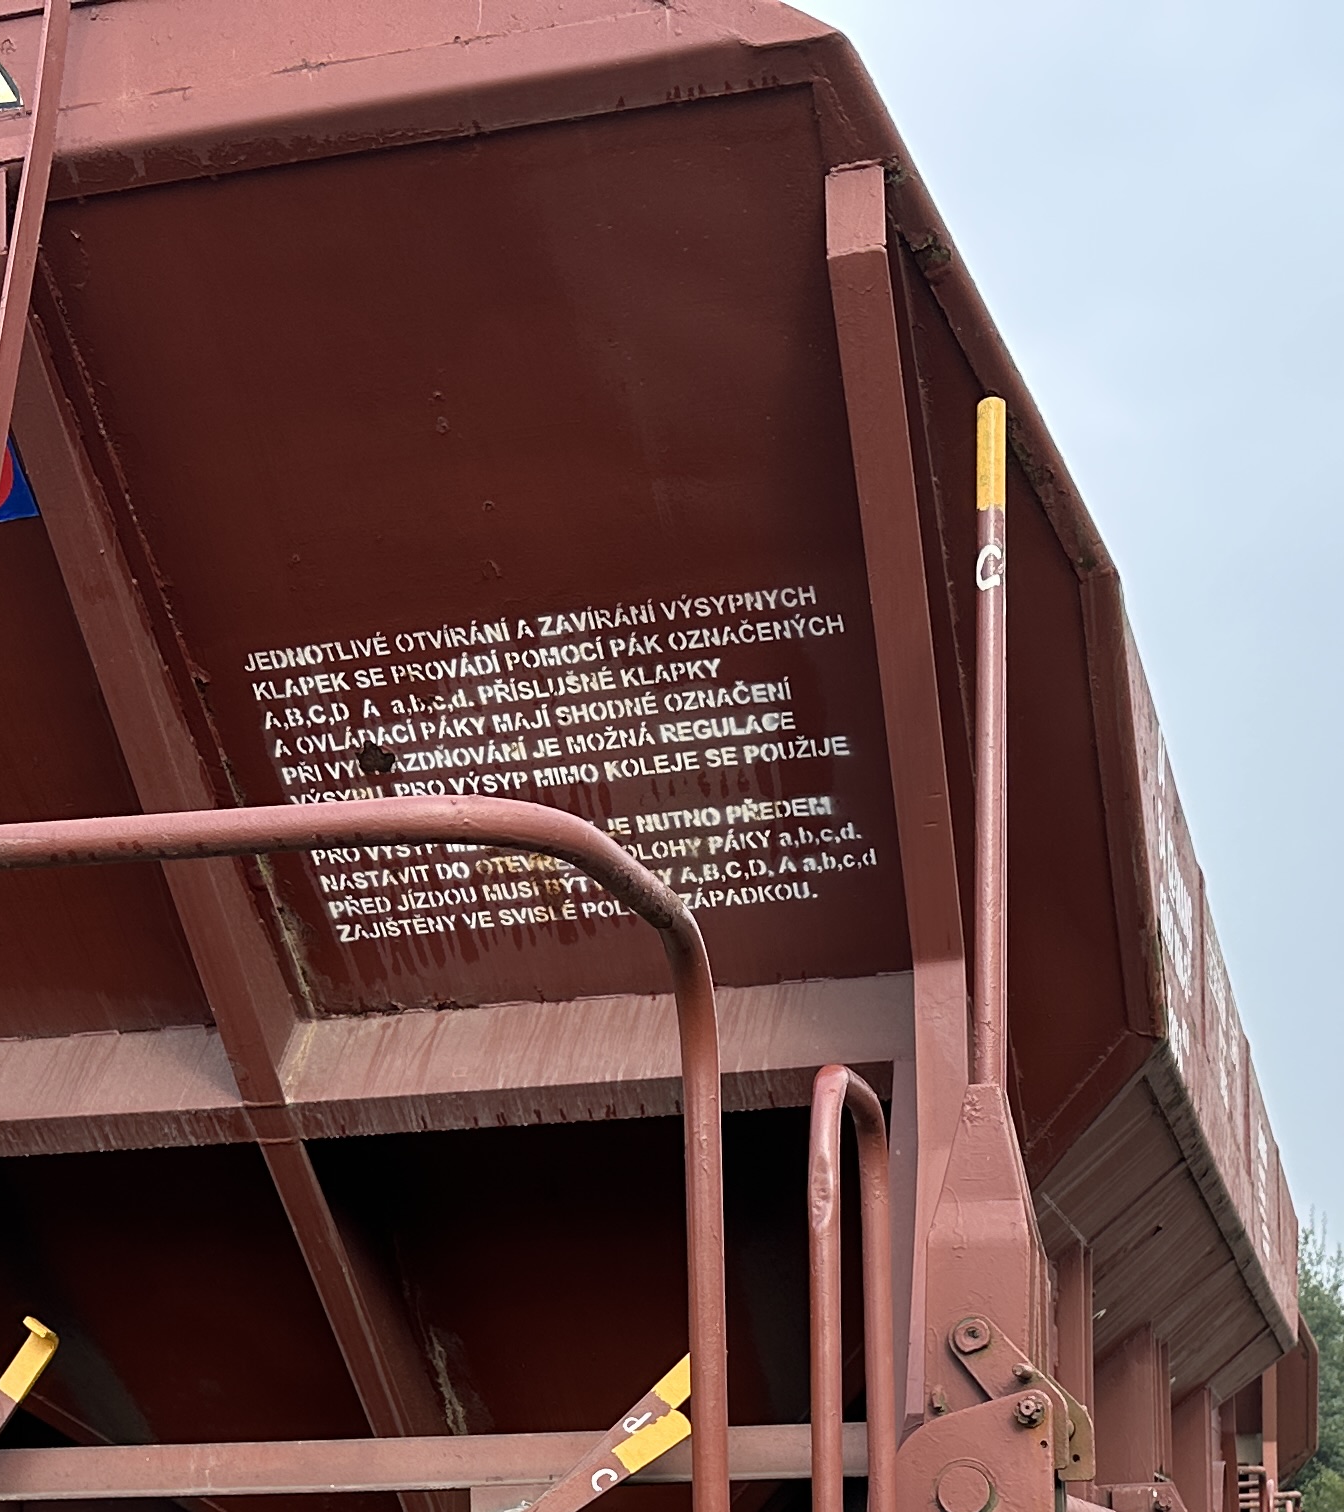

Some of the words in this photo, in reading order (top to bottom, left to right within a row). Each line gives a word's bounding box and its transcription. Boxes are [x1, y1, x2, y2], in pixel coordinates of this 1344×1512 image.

[244, 632, 391, 673] JEDNOTLIVÉ
[395, 617, 511, 653] OTVÍRÁNÍ
[517, 618, 535, 641] A
[537, 599, 657, 638] ZAVÍRÁNÍ
[252, 671, 351, 702] KLAPEK
[354, 667, 388, 689] SE
[390, 649, 501, 685] PROVÁDÍ
[505, 636, 605, 671] POMOCÍ
[611, 631, 664, 659] PÁK
[667, 613, 846, 651] OZNAČENÝCH
[265, 703, 350, 731] A,B,C,D
[363, 699, 381, 719] A
[391, 689, 474, 716] a,b,c,d.
[477, 666, 617, 706] PŘÍSLUŠNÉ
[620, 658, 720, 689] KLAPKY
[274, 738, 291, 758] A
[296, 718, 417, 755] OVLÁDACÍ
[420, 714, 486, 741] PÁKY
[492, 703, 551, 734] MAJÍ
[555, 691, 658, 727] SHODNÉ
[664, 676, 792, 712] OZNAČENÍ
[281, 760, 323, 786] PŘI
[532, 738, 560, 760] JE
[565, 722, 656, 756] MOŽNÁ
[659, 712, 796, 744] REGULACE
[394, 779, 446, 799] PRO
[448, 769, 529, 796] VÝSYP
[533, 763, 599, 788] MIMO
[605, 750, 700, 783] KOLEJE
[705, 746, 738, 769] SE
[744, 735, 850, 765] POUŽIJE
[310, 846, 361, 866] PRO
[636, 806, 721, 834] NUTNO
[726, 797, 833, 826] PŘEDEM
[320, 863, 430, 893] NASTAVIT
[435, 861, 470, 880] DO
[707, 828, 771, 855] PÁKY
[778, 821, 863, 848] a,b,c,d.
[327, 895, 391, 920] PŘED
[397, 886, 478, 912] JÍZDOU
[482, 879, 540, 902] MUSÍ
[543, 872, 589, 896] BÝT
[779, 855, 798, 875] A
[336, 914, 457, 943] ZAJIŠTĚNY
[462, 910, 495, 930] VE
[500, 899, 578, 927] SVISLÉ
[677, 881, 819, 911] ZÁPADKOU.
